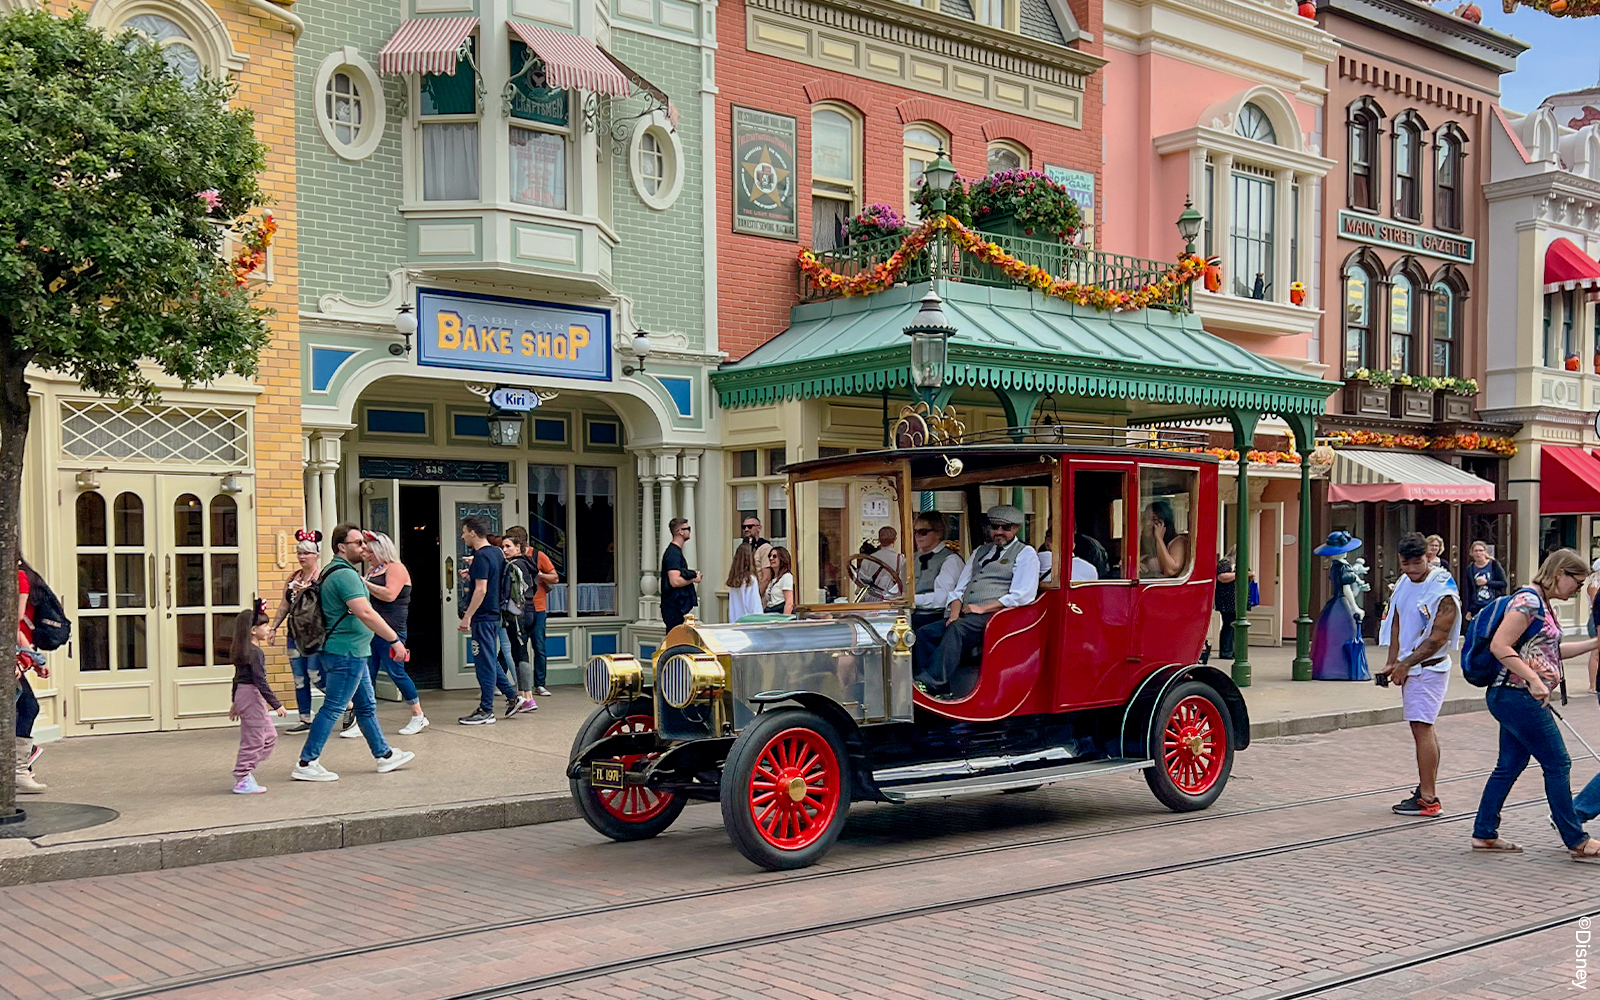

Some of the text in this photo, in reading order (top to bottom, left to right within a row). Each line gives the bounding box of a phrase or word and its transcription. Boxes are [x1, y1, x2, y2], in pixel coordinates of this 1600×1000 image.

[515, 94, 564, 119] CRAFTSMEN
[1049, 169, 1085, 183] POPULAR
[1069, 180, 1092, 191] GAME
[1345, 217, 1467, 257] MAIN STREET GAZETTE
[467, 313, 564, 331] CABLE CAR
[437, 309, 591, 361] BAKE SHOP
[606, 769, 619, 781] 1971
